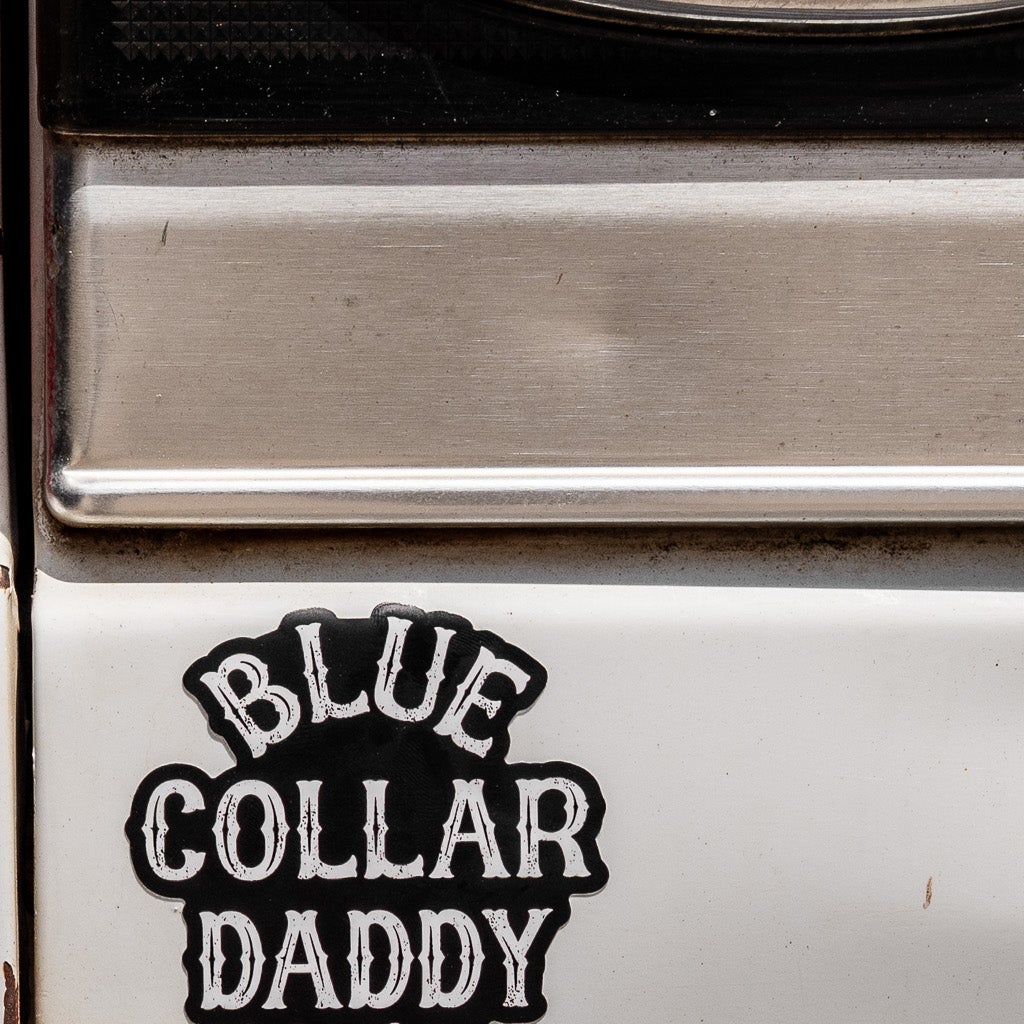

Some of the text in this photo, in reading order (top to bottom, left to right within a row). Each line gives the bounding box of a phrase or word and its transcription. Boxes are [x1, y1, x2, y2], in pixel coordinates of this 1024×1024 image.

[200, 616, 532, 758] BLUE
[141, 778, 591, 881] COLLAR
[199, 908, 554, 1010] DADDY
